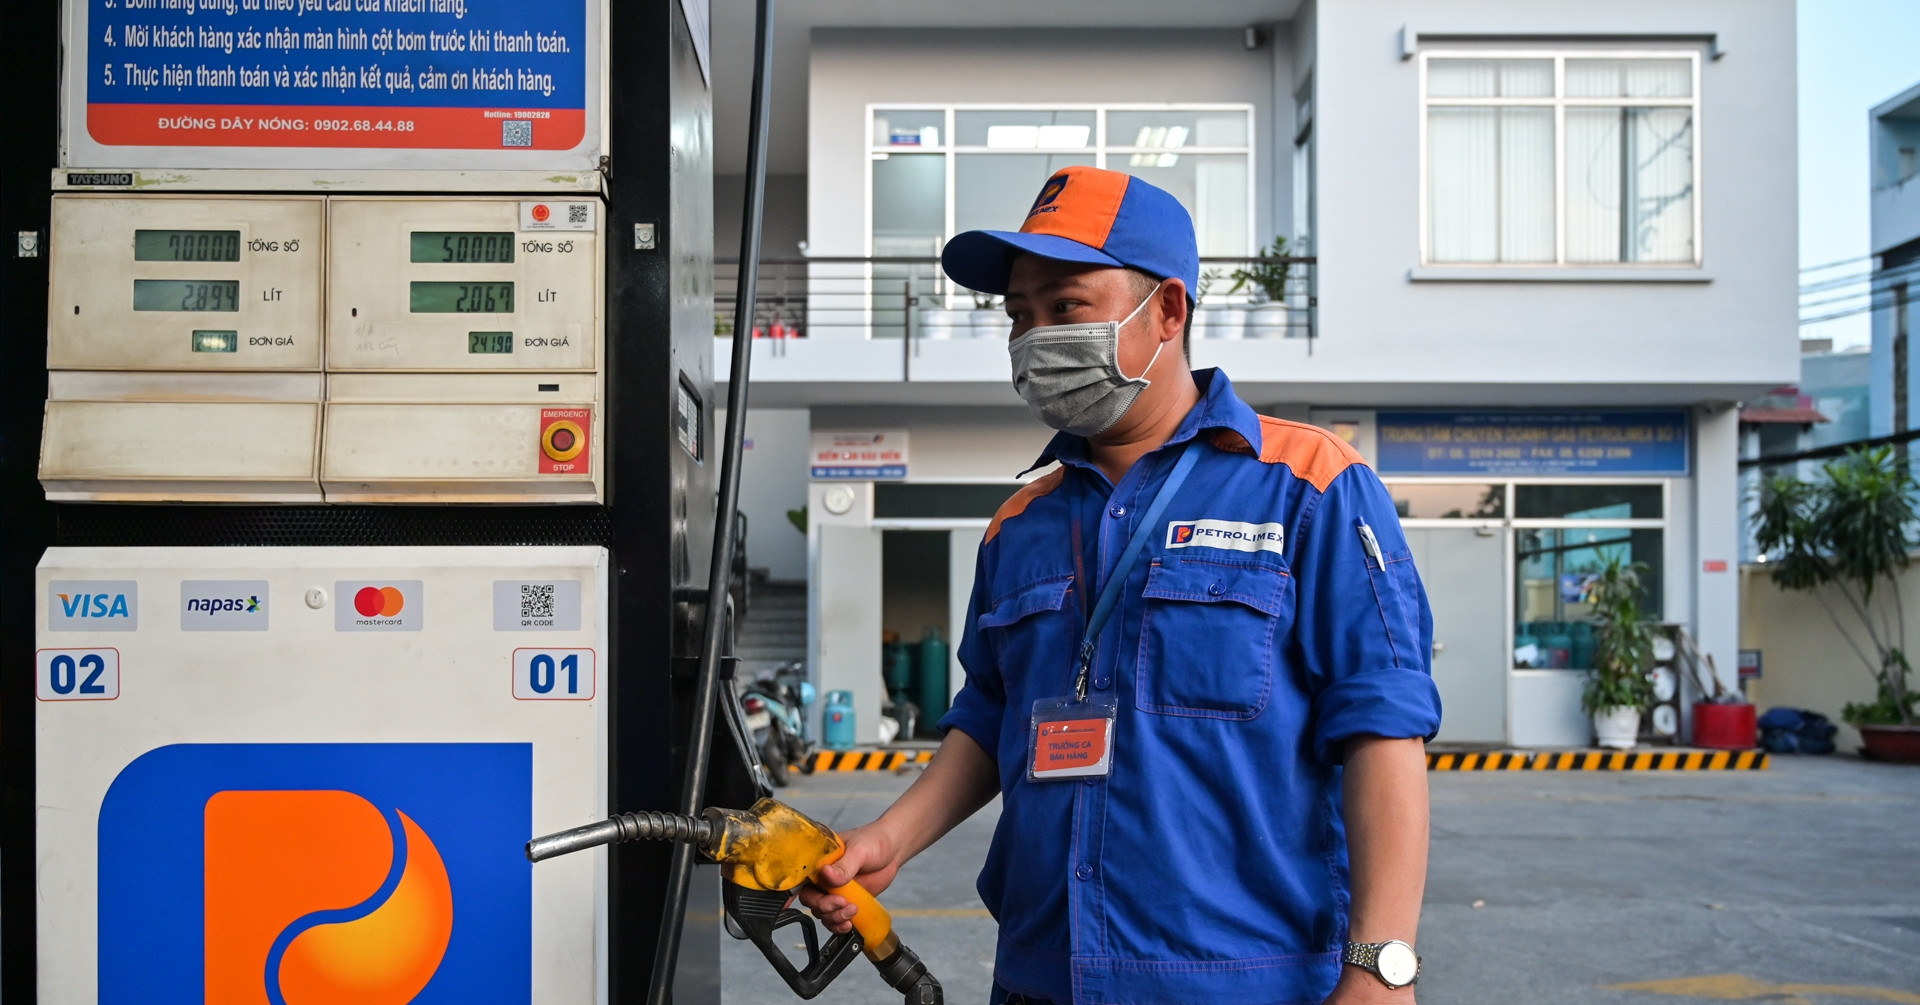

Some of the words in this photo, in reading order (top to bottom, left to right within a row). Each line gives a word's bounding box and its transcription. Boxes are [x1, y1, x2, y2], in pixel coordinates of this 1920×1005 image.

[104, 26, 116, 47] 4.
[125, 25, 149, 48] Mời
[153, 26, 195, 48] khách
[199, 26, 233, 54] hàng
[237, 26, 262, 49] xác
[265, 27, 300, 54] nhận
[304, 27, 333, 50] màn
[337, 28, 368, 50] hình
[371, 28, 393, 56] cột
[396, 28, 426, 51] bơm
[430, 29, 466, 52] trước
[469, 30, 490, 52] khi
[493, 30, 533, 52] thanh
[536, 30, 570, 53] toán.
[104, 64, 116, 86] 5.
[124, 63, 159, 91] Thực
[163, 63, 193, 92] hiện
[196, 64, 236, 87] thanh
[239, 64, 270, 87] toán
[273, 64, 290, 88] và
[293, 65, 318, 88] xác
[322, 65, 356, 94] nhận
[360, 64, 382, 89] kết
[385, 65, 415, 95] quả,
[418, 65, 448, 90] cảm
[451, 71, 468, 90] ơn
[472, 67, 514, 91] khách
[517, 68, 556, 97] hàng.
[484, 110, 513, 118] Hotline:
[514, 111, 551, 119] 19002828
[158, 116, 216, 130] ĐƯỜNG
[221, 117, 254, 130] DÂY
[258, 118, 309, 131] NÓNG:
[314, 119, 415, 132] 0902.68.44.88
[70, 174, 130, 185] TATSUNO
[169, 234, 237, 261] 70000
[247, 237, 279, 252] TỔNG
[283, 239, 301, 252] SỐ
[442, 236, 512, 263] 50000
[521, 240, 553, 253] TỔNG
[557, 240, 575, 254] SỐ
[181, 284, 237, 311] 2.894
[263, 287, 283, 302] LÍT
[456, 286, 512, 313] 2.067
[538, 289, 557, 303] LÍT
[249, 336, 273, 346] ĐƠN
[275, 335, 295, 346] GIÁ
[472, 336, 513, 352] 24190
[525, 337, 548, 347] ĐƠN
[550, 336, 570, 347] GIÁ
[543, 410, 589, 418] EMERGENCY
[553, 464, 575, 472] STOP
[1195, 528, 1283, 544] PETROLIMEX
[56, 593, 130, 618] VISA
[187, 597, 244, 616] napas
[356, 618, 403, 626] mastercard
[521, 619, 532, 627] QR
[533, 619, 555, 627] CODE
[50, 653, 106, 695] 02
[529, 653, 579, 695] 01
